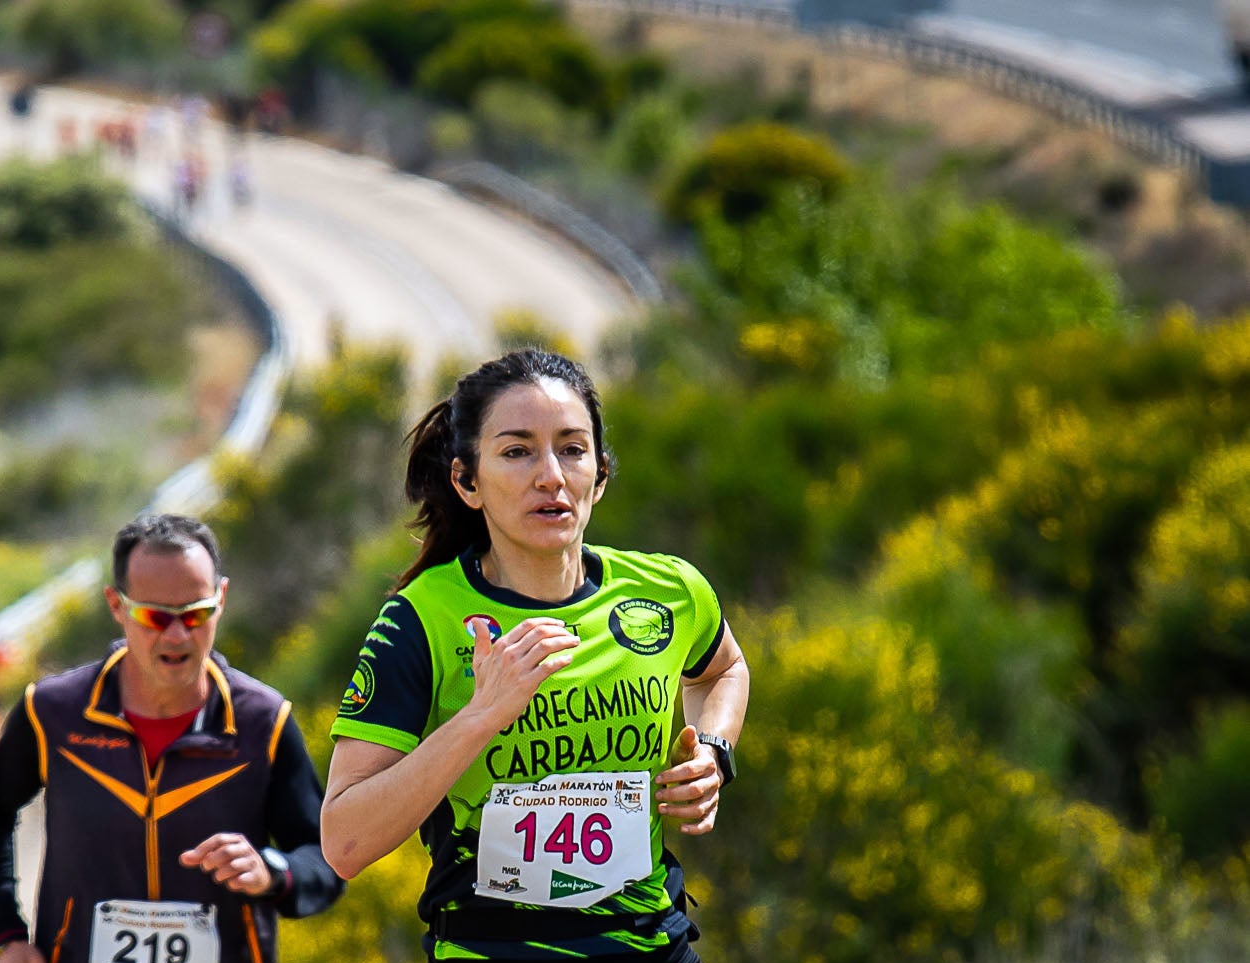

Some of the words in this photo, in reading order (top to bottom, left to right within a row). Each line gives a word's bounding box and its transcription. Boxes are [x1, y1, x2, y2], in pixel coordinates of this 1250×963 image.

[486, 723, 662, 780] CARBAJOSA
[494, 797, 509, 805] DE
[513, 796, 555, 806] CIUDAD
[559, 795, 608, 806] RODRIGO
[526, 783, 557, 792] EDIA
[560, 780, 613, 791] MARATÓN
[514, 811, 613, 865] 146
